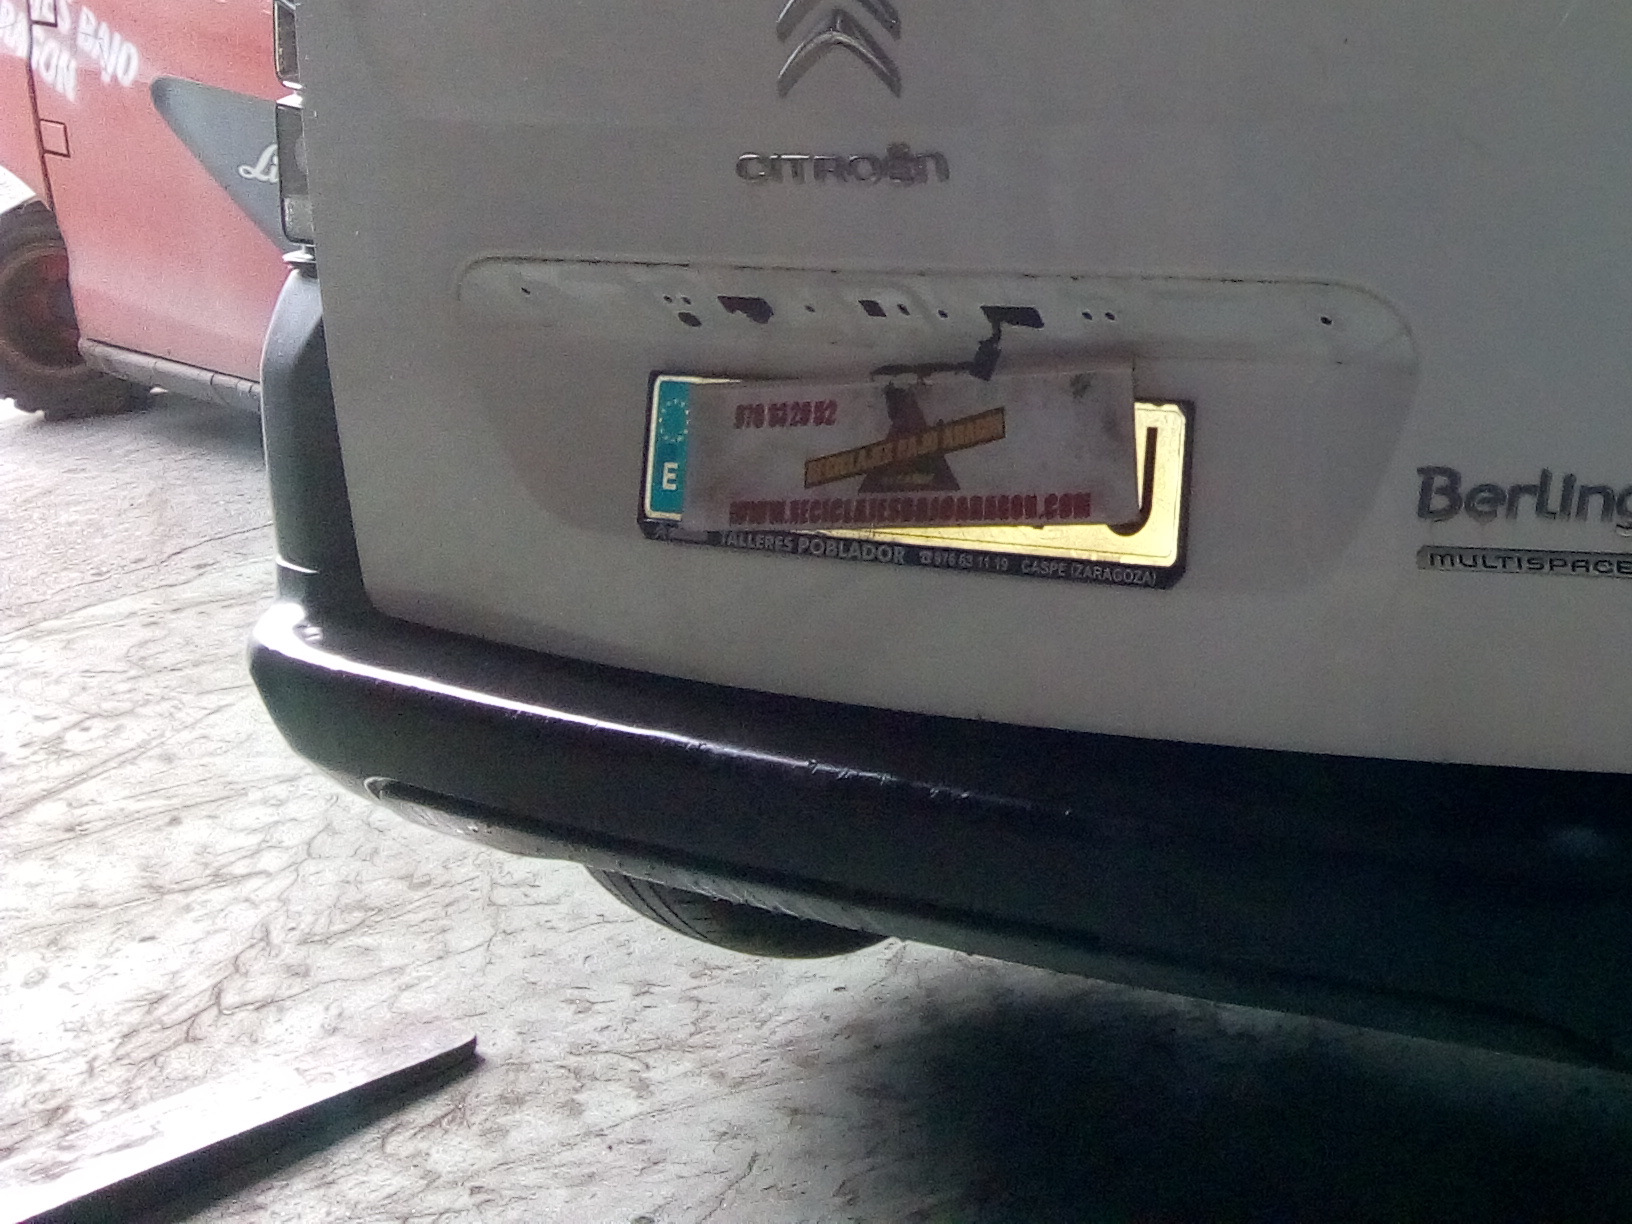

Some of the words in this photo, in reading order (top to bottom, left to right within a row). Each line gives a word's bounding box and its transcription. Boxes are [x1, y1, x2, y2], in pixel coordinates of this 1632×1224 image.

[662, 462, 678, 490] E
[721, 531, 793, 552] TALLERES
[798, 536, 905, 564] POBLADOR
[1021, 559, 1066, 576] CASPE
[1070, 562, 1156, 587] (ZARAGOZA)
